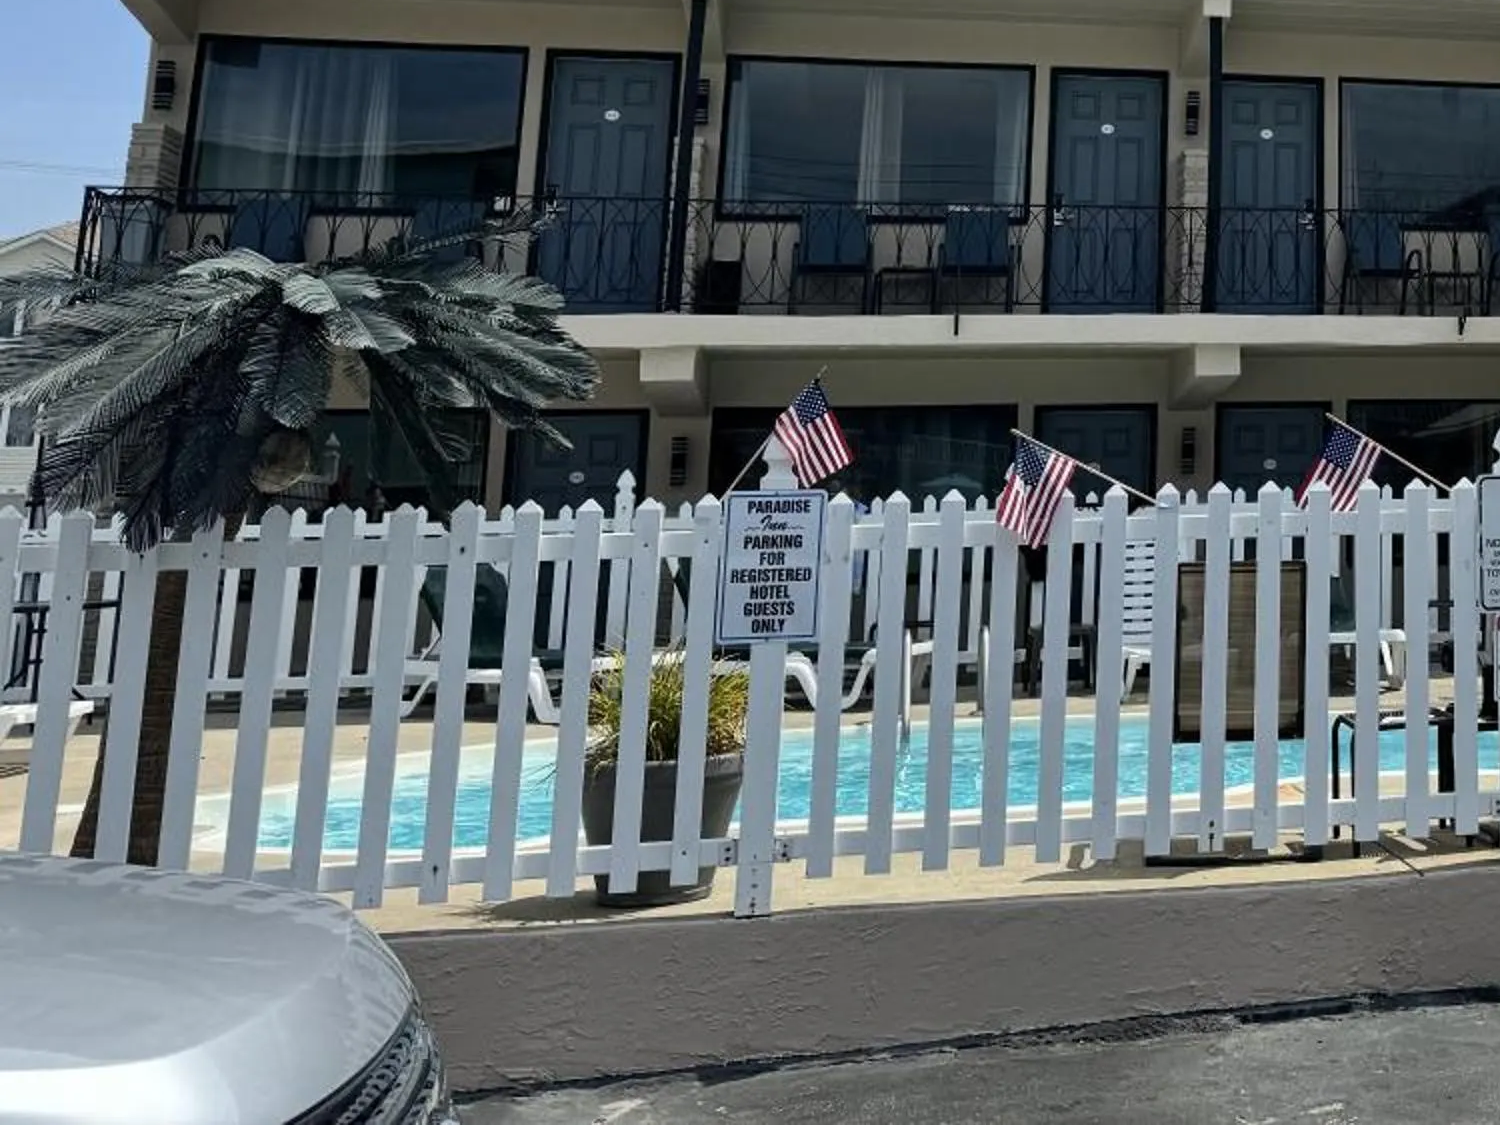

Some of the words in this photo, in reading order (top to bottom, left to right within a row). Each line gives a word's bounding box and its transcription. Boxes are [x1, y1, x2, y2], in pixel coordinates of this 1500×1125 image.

[747, 500, 812, 514] PARADISE
[760, 515, 788, 531] Inn
[743, 534, 803, 550] PARKING
[1485, 538, 1500, 548] NO
[759, 551, 785, 566] FOR
[730, 567, 812, 583] REGISTERED
[749, 584, 790, 600] HOTEL
[743, 601, 795, 617] GUESTS
[751, 618, 785, 634] ONLY
